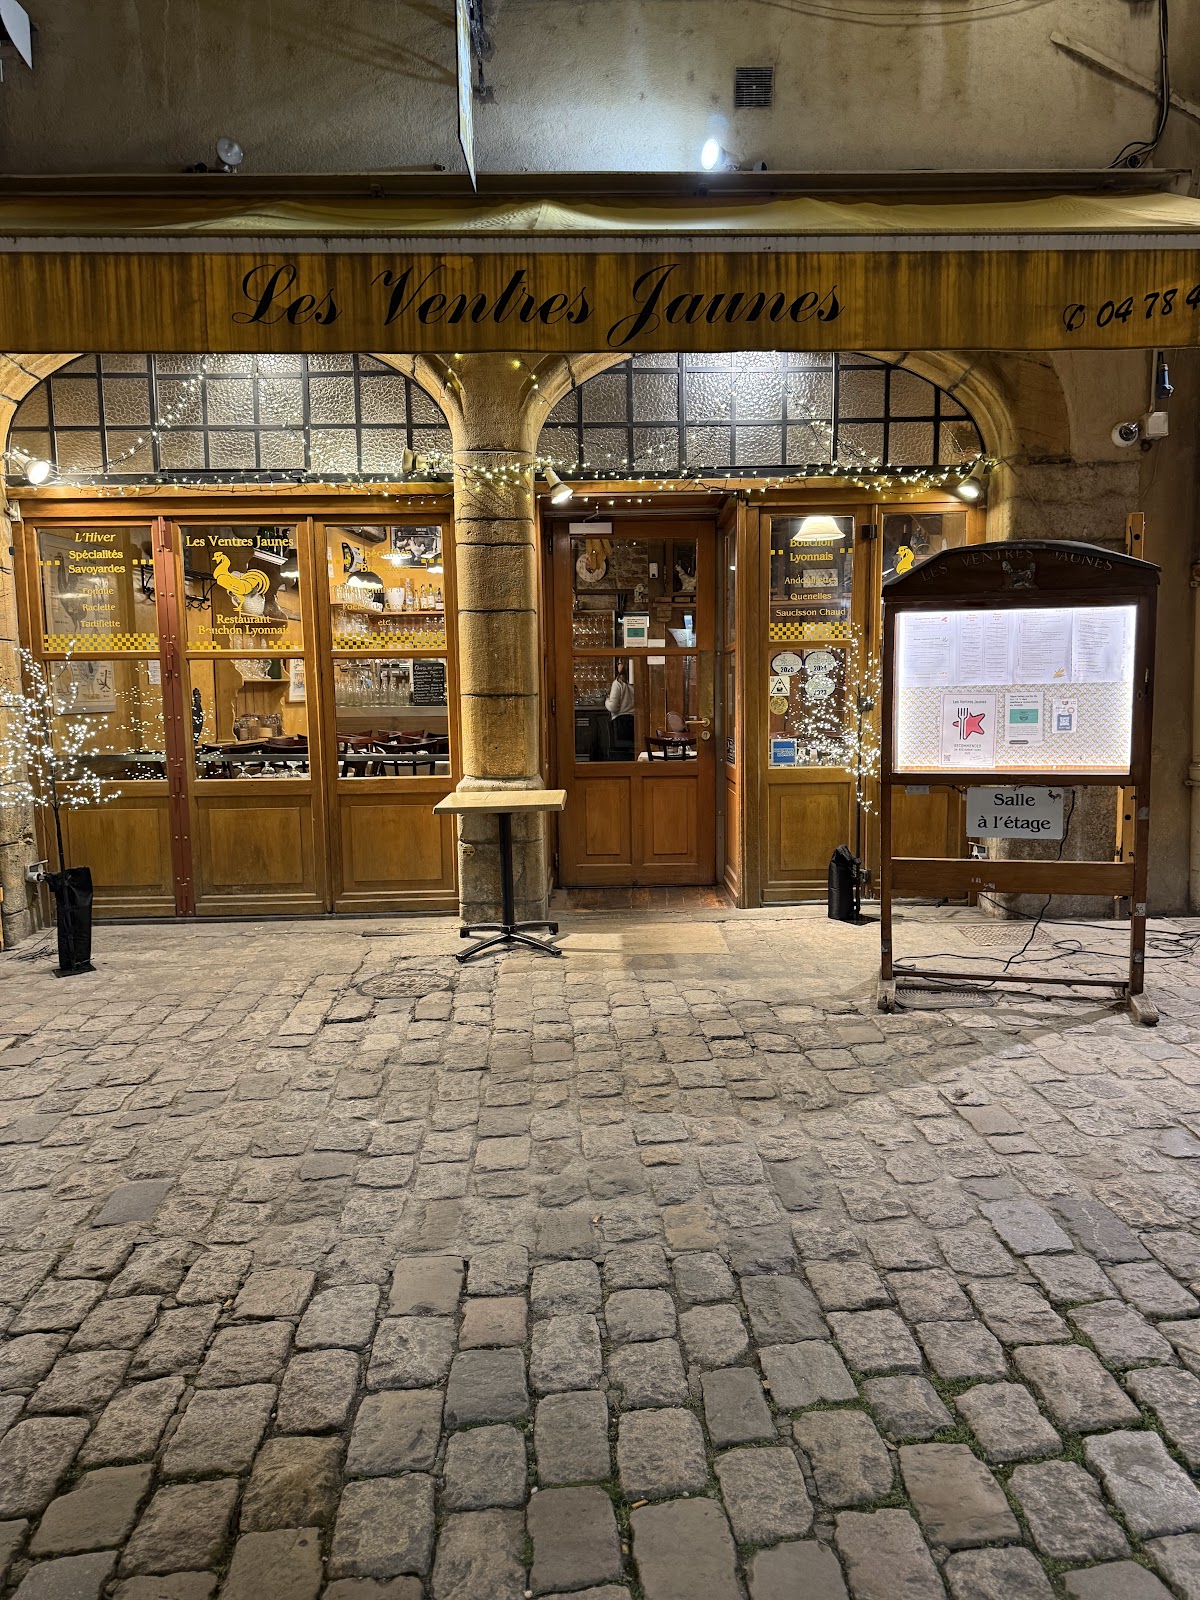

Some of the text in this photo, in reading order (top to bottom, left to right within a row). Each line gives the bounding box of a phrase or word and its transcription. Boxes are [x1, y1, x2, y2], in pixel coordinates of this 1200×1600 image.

[232, 263, 846, 347] Les Ventres Jaunes
[1096, 296, 1134, 328] 04
[1144, 288, 1178, 319] 78
[75, 532, 116, 542] L'Hiver
[186, 535, 294, 548] Les Ventres Jaunes
[68, 549, 124, 561] Spécialités
[789, 552, 834, 564] Lyonnais
[68, 564, 126, 575] Savoyardes
[920, 549, 1113, 582] LES VENTRES JAUNES
[790, 593, 832, 601] Quenelles
[82, 603, 116, 611] Raclette
[776, 608, 846, 618] Saucisson Chaud
[81, 620, 121, 628] Tartiflette
[216, 614, 271, 624] Restaurant
[245, 625, 291, 637] Lyonnais
[993, 793, 1036, 807] Salle
[977, 815, 1051, 833] à l'étage
